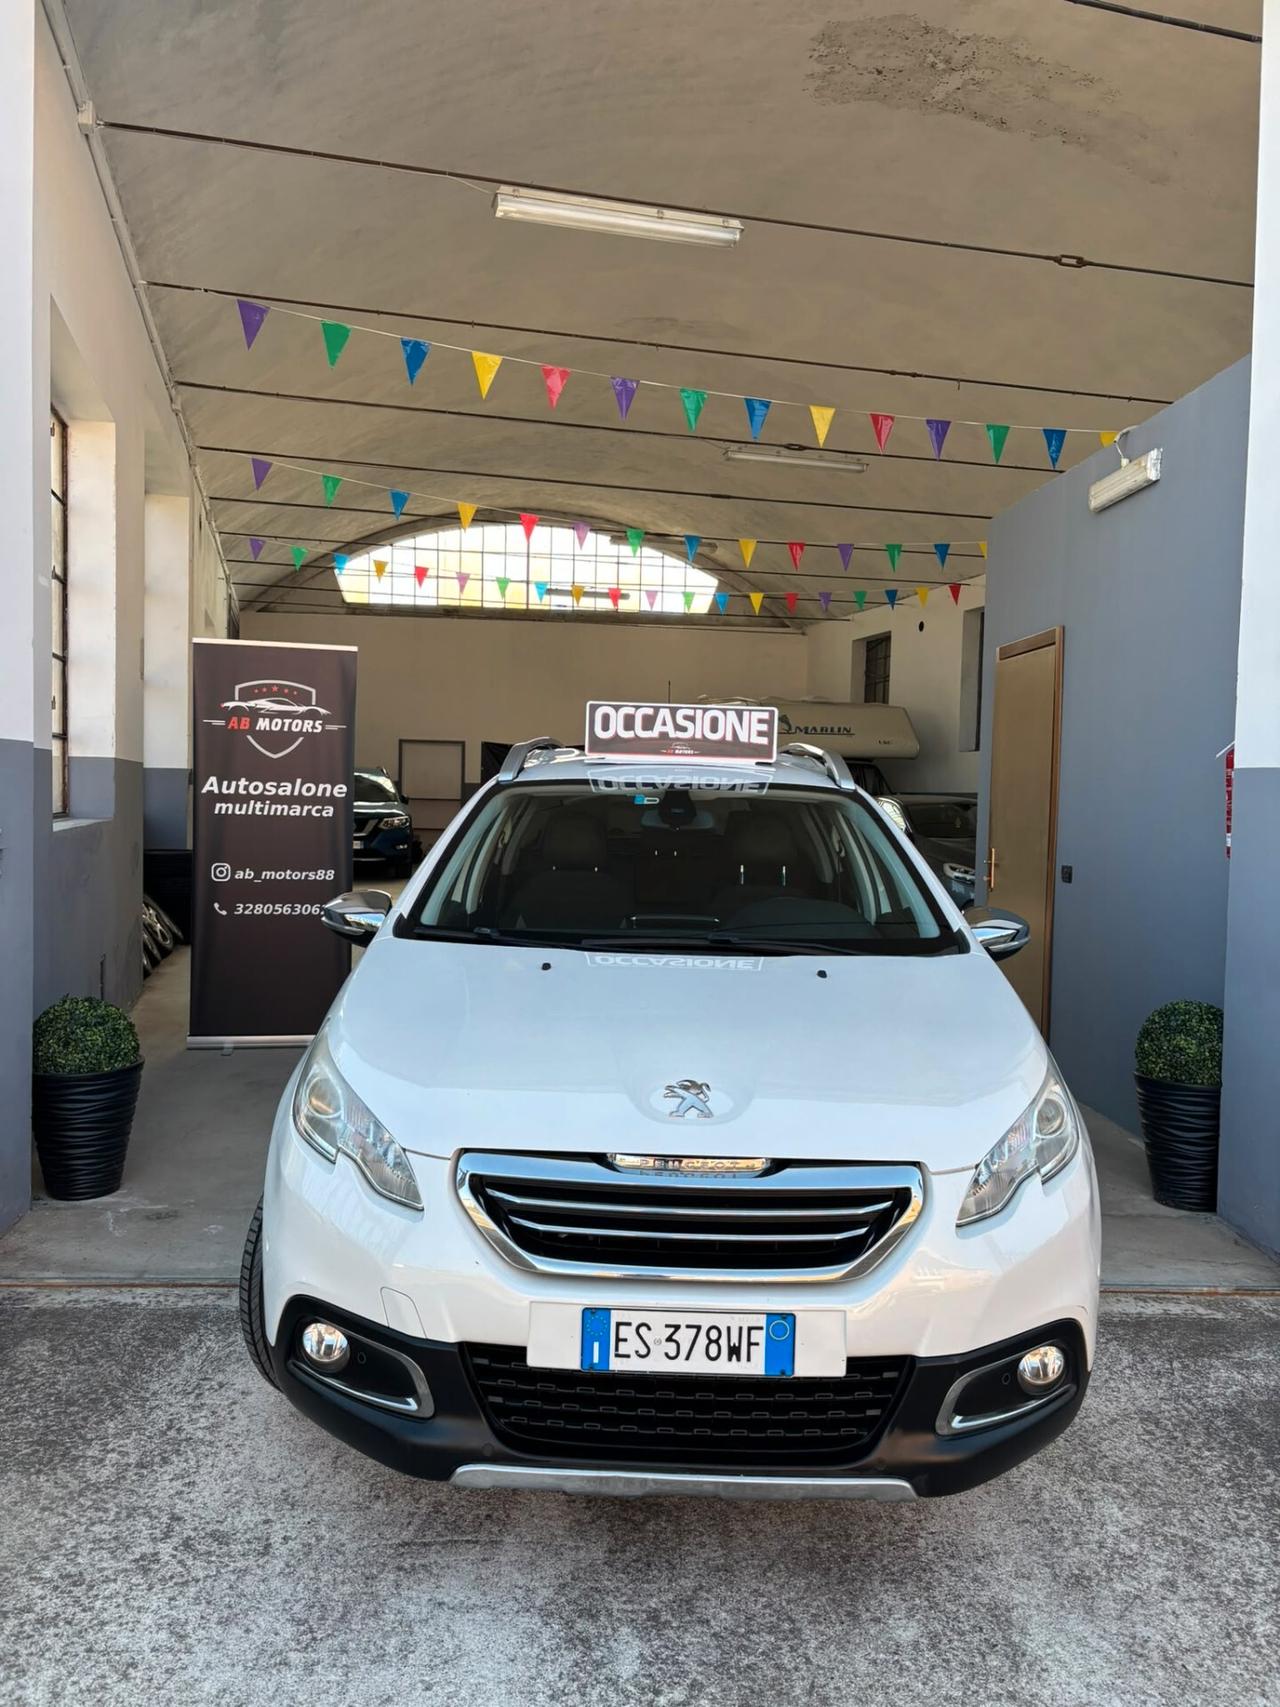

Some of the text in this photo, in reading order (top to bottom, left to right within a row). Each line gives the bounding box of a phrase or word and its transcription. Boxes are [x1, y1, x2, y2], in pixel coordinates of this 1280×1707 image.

[227, 716, 323, 733] AB MOTORS
[594, 705, 770, 745] OCCASIONE
[201, 775, 348, 797] Autosalone
[214, 800, 334, 817] multimarca
[234, 868, 335, 882] ab_motors88
[639, 1158, 739, 1170] PEUGEOT
